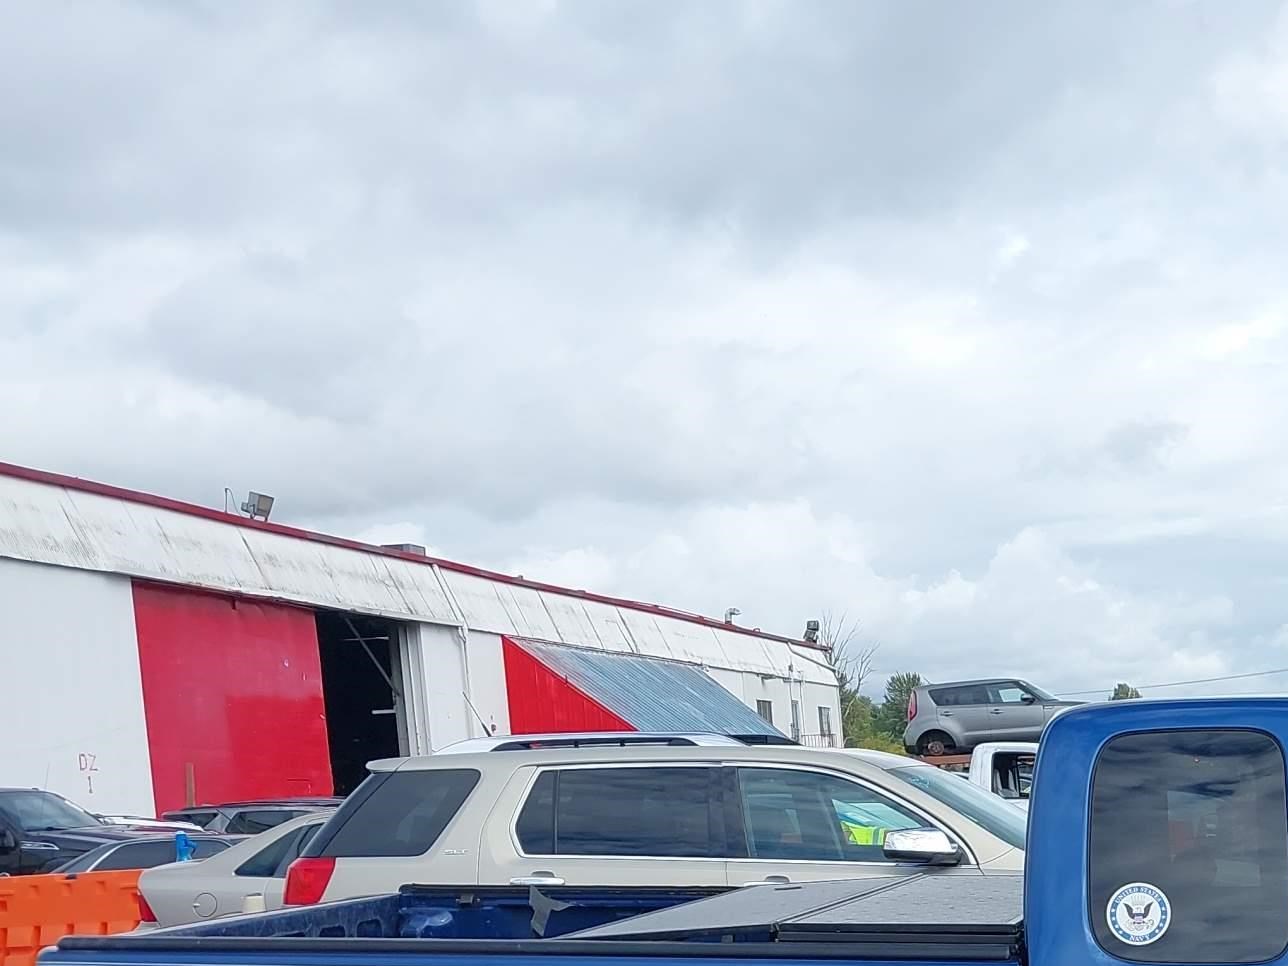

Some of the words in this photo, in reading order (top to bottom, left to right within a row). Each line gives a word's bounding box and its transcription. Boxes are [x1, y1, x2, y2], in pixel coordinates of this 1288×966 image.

[1114, 887, 1138, 903] UNITED
[1140, 887, 1162, 902] STATES
[1129, 934, 1151, 943] NAVY
